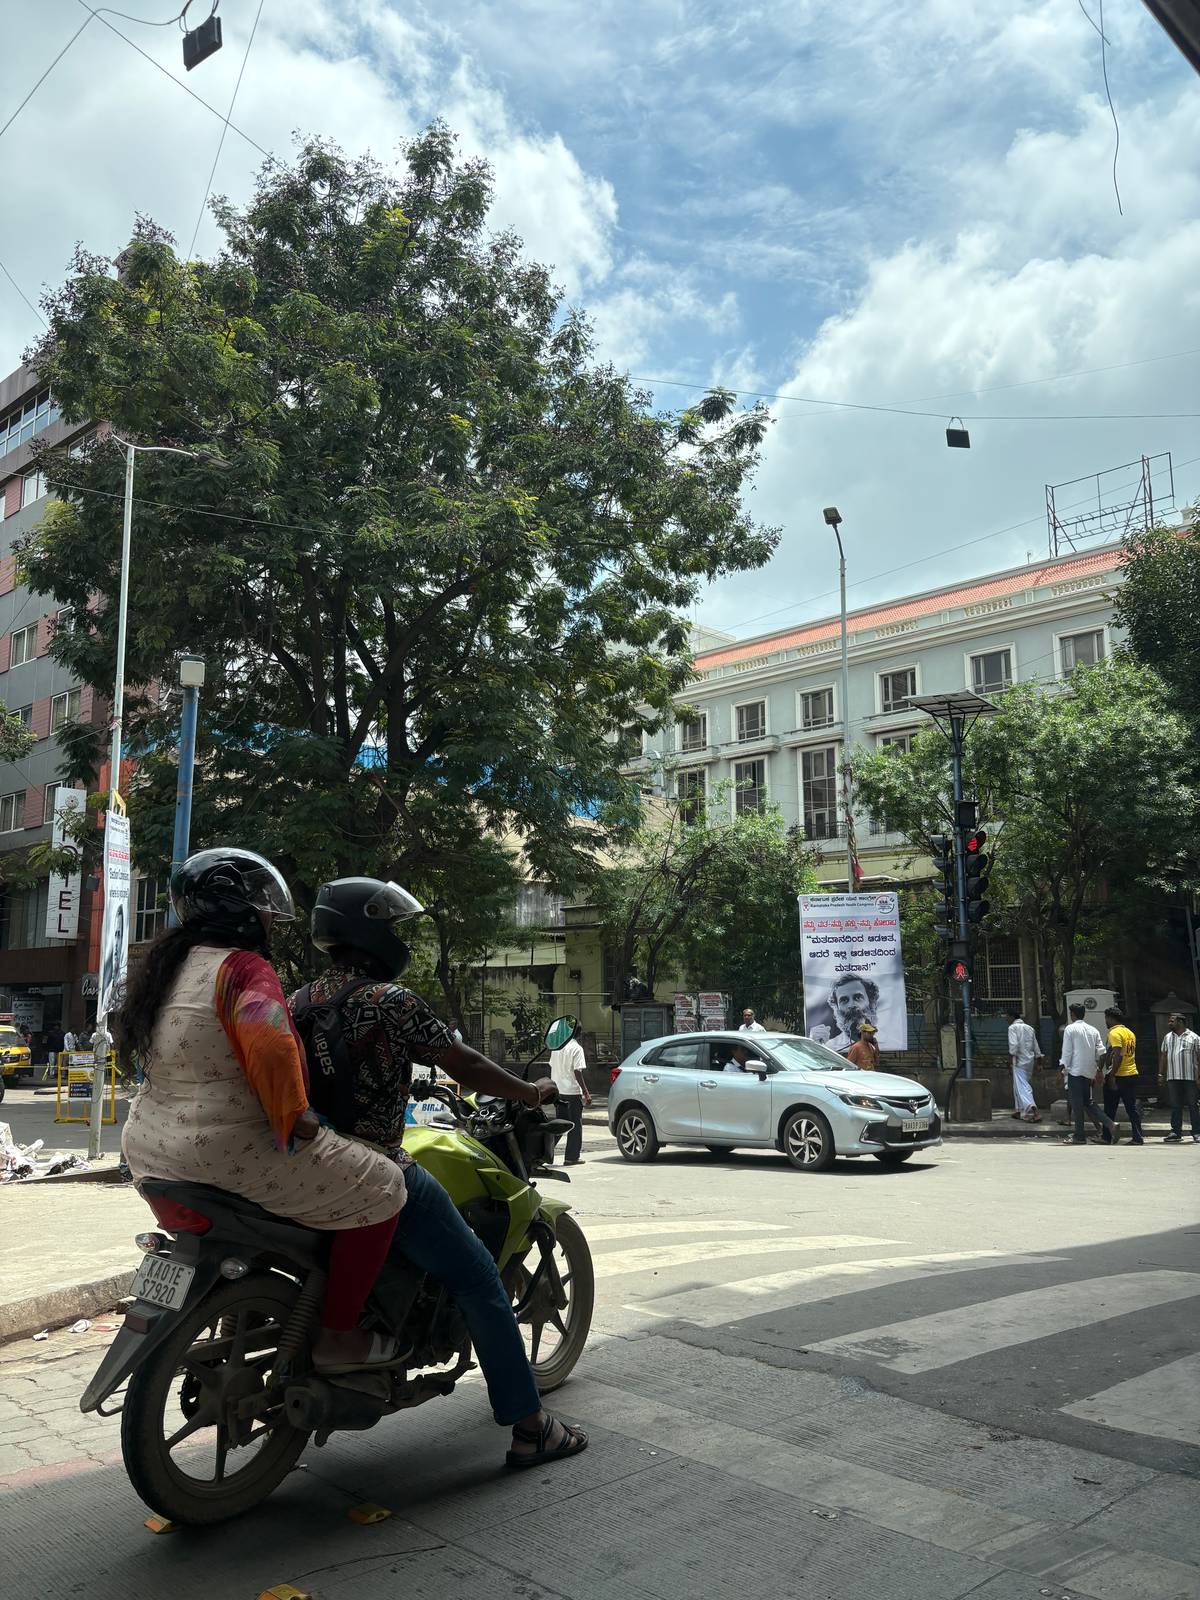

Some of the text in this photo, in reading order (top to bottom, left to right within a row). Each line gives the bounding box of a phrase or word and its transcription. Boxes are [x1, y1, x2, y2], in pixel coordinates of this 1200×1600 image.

[809, 949, 829, 958] ಆದರೆ
[313, 1032, 335, 1075] safari
[147, 1259, 184, 1285] KA01E
[139, 1279, 175, 1304] S7920
